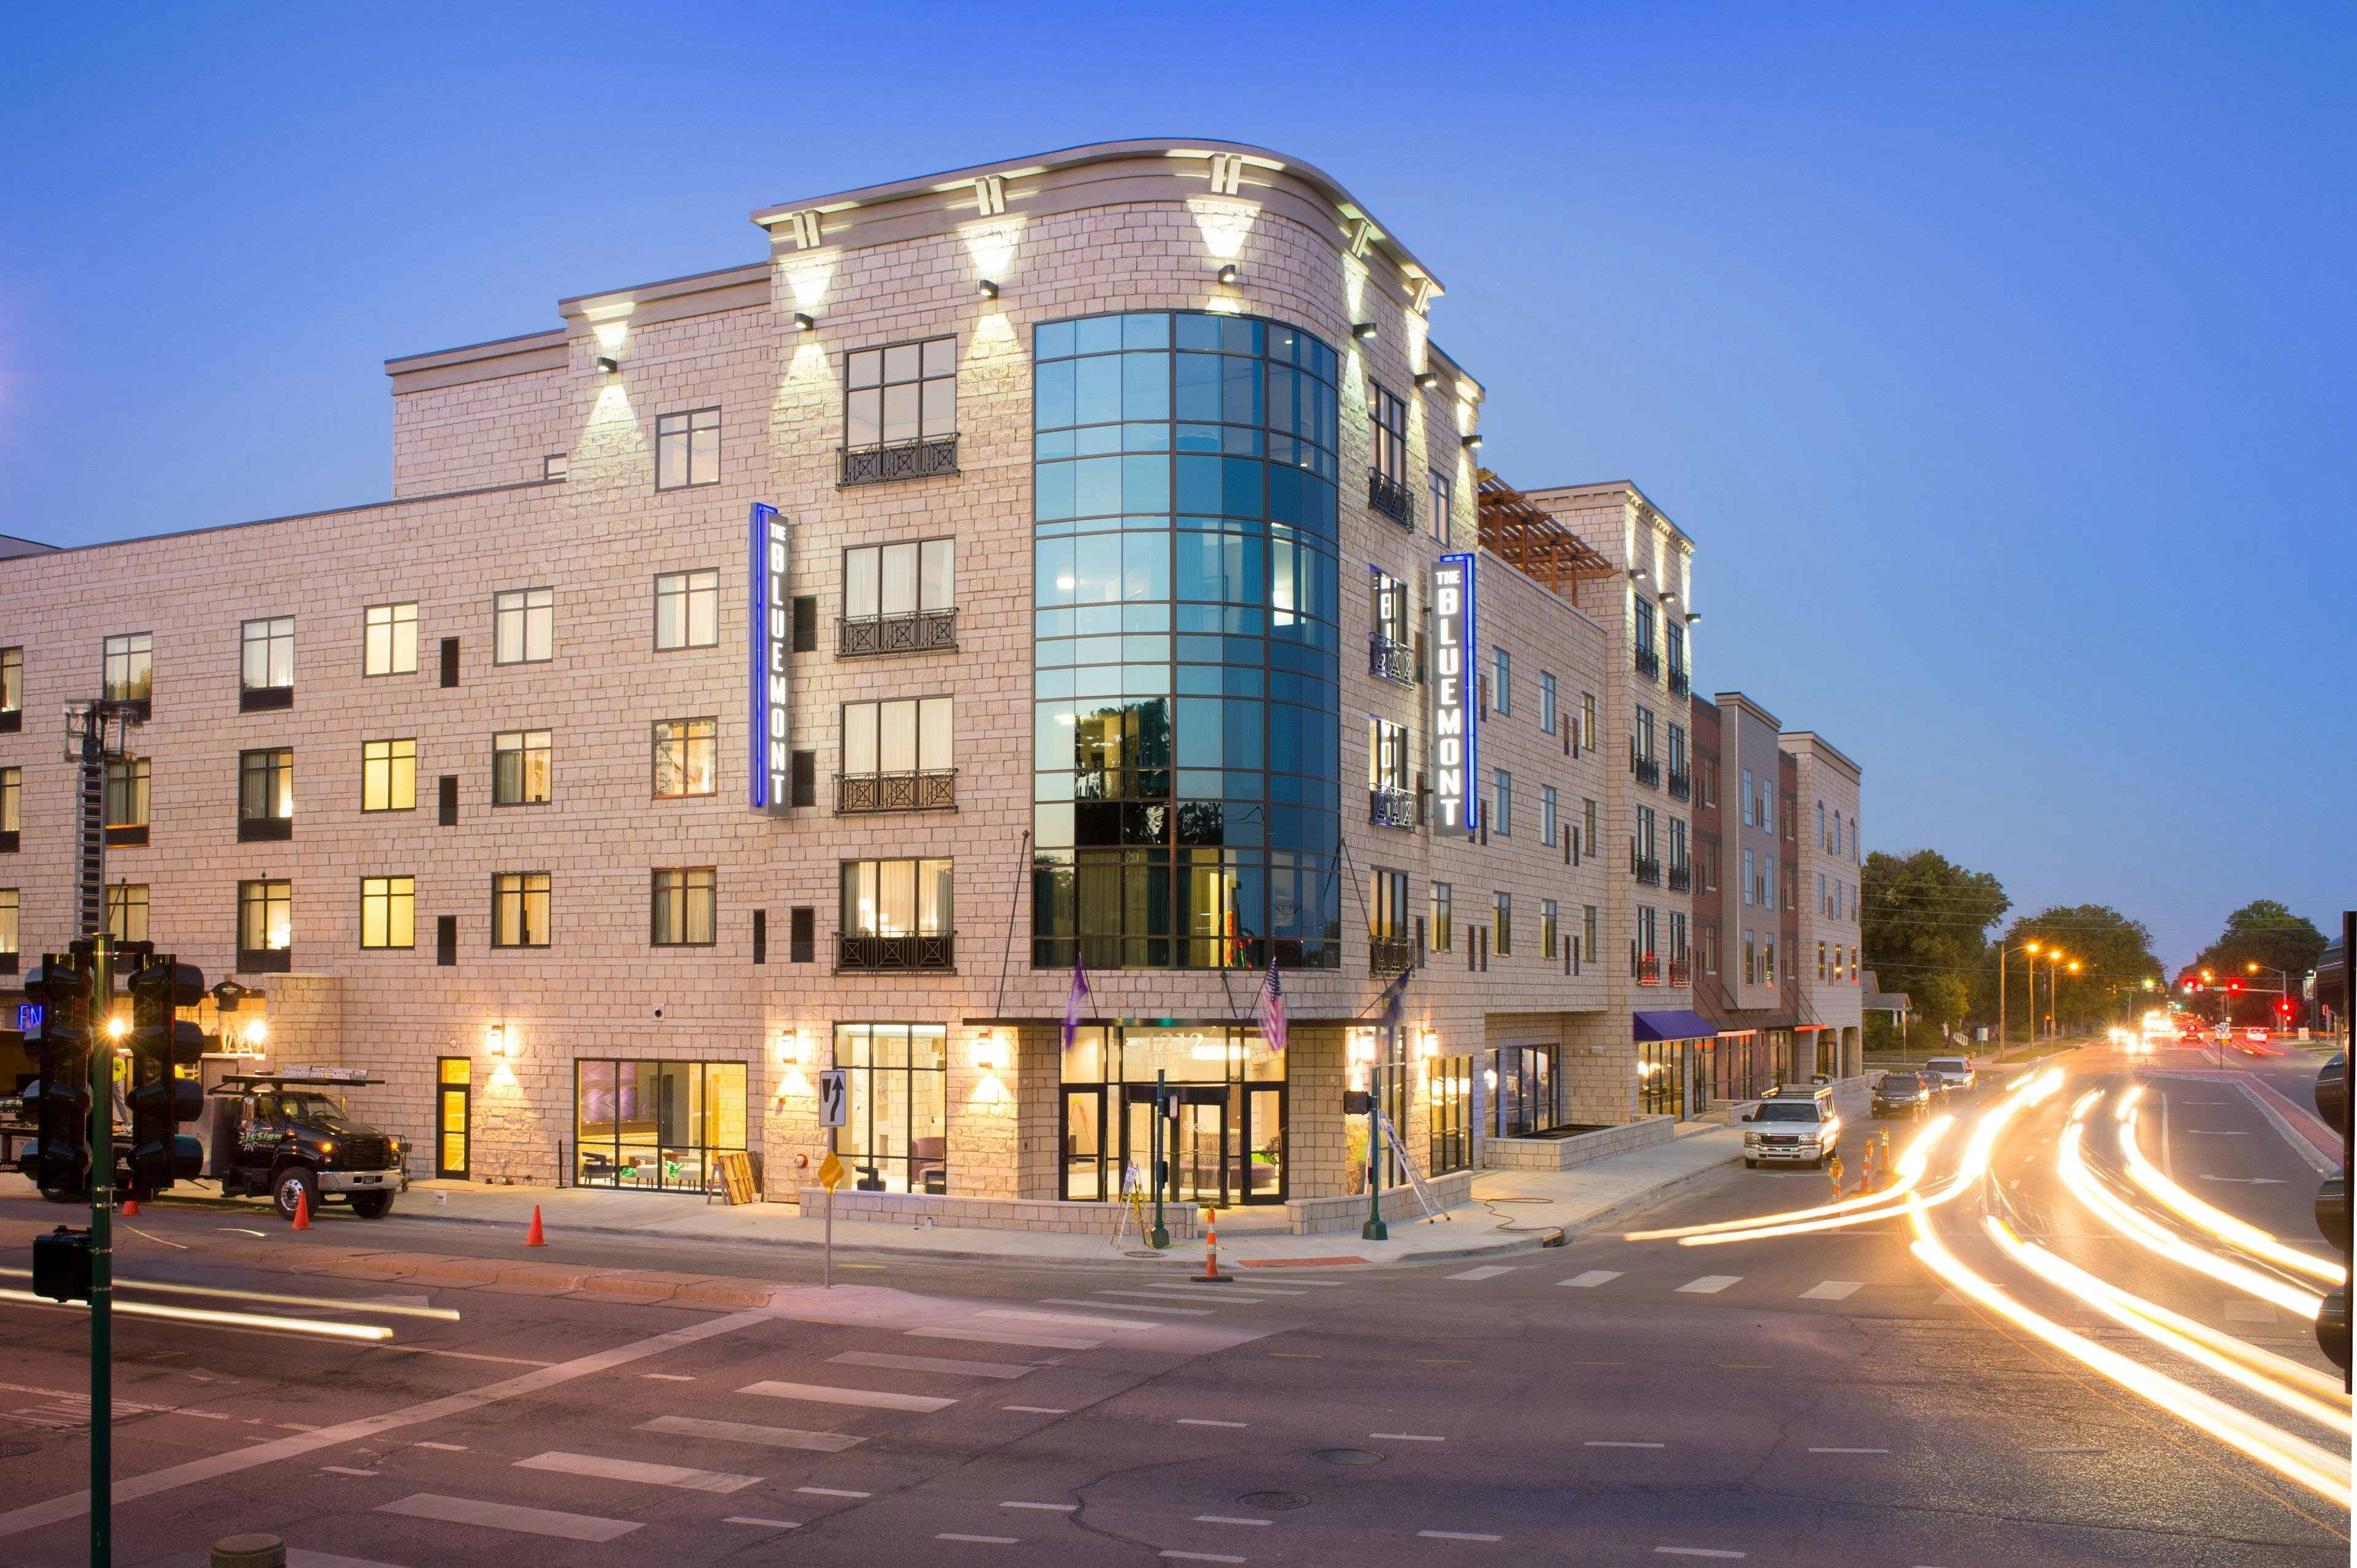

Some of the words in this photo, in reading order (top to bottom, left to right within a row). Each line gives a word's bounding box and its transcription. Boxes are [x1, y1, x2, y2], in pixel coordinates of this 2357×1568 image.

[770, 522, 786, 541] THE
[1435, 570, 1460, 585] THE
[770, 543, 785, 803] BLUEMONT
[1438, 588, 1460, 826] BLUEMONT
[1147, 1031, 1204, 1054] 1212
